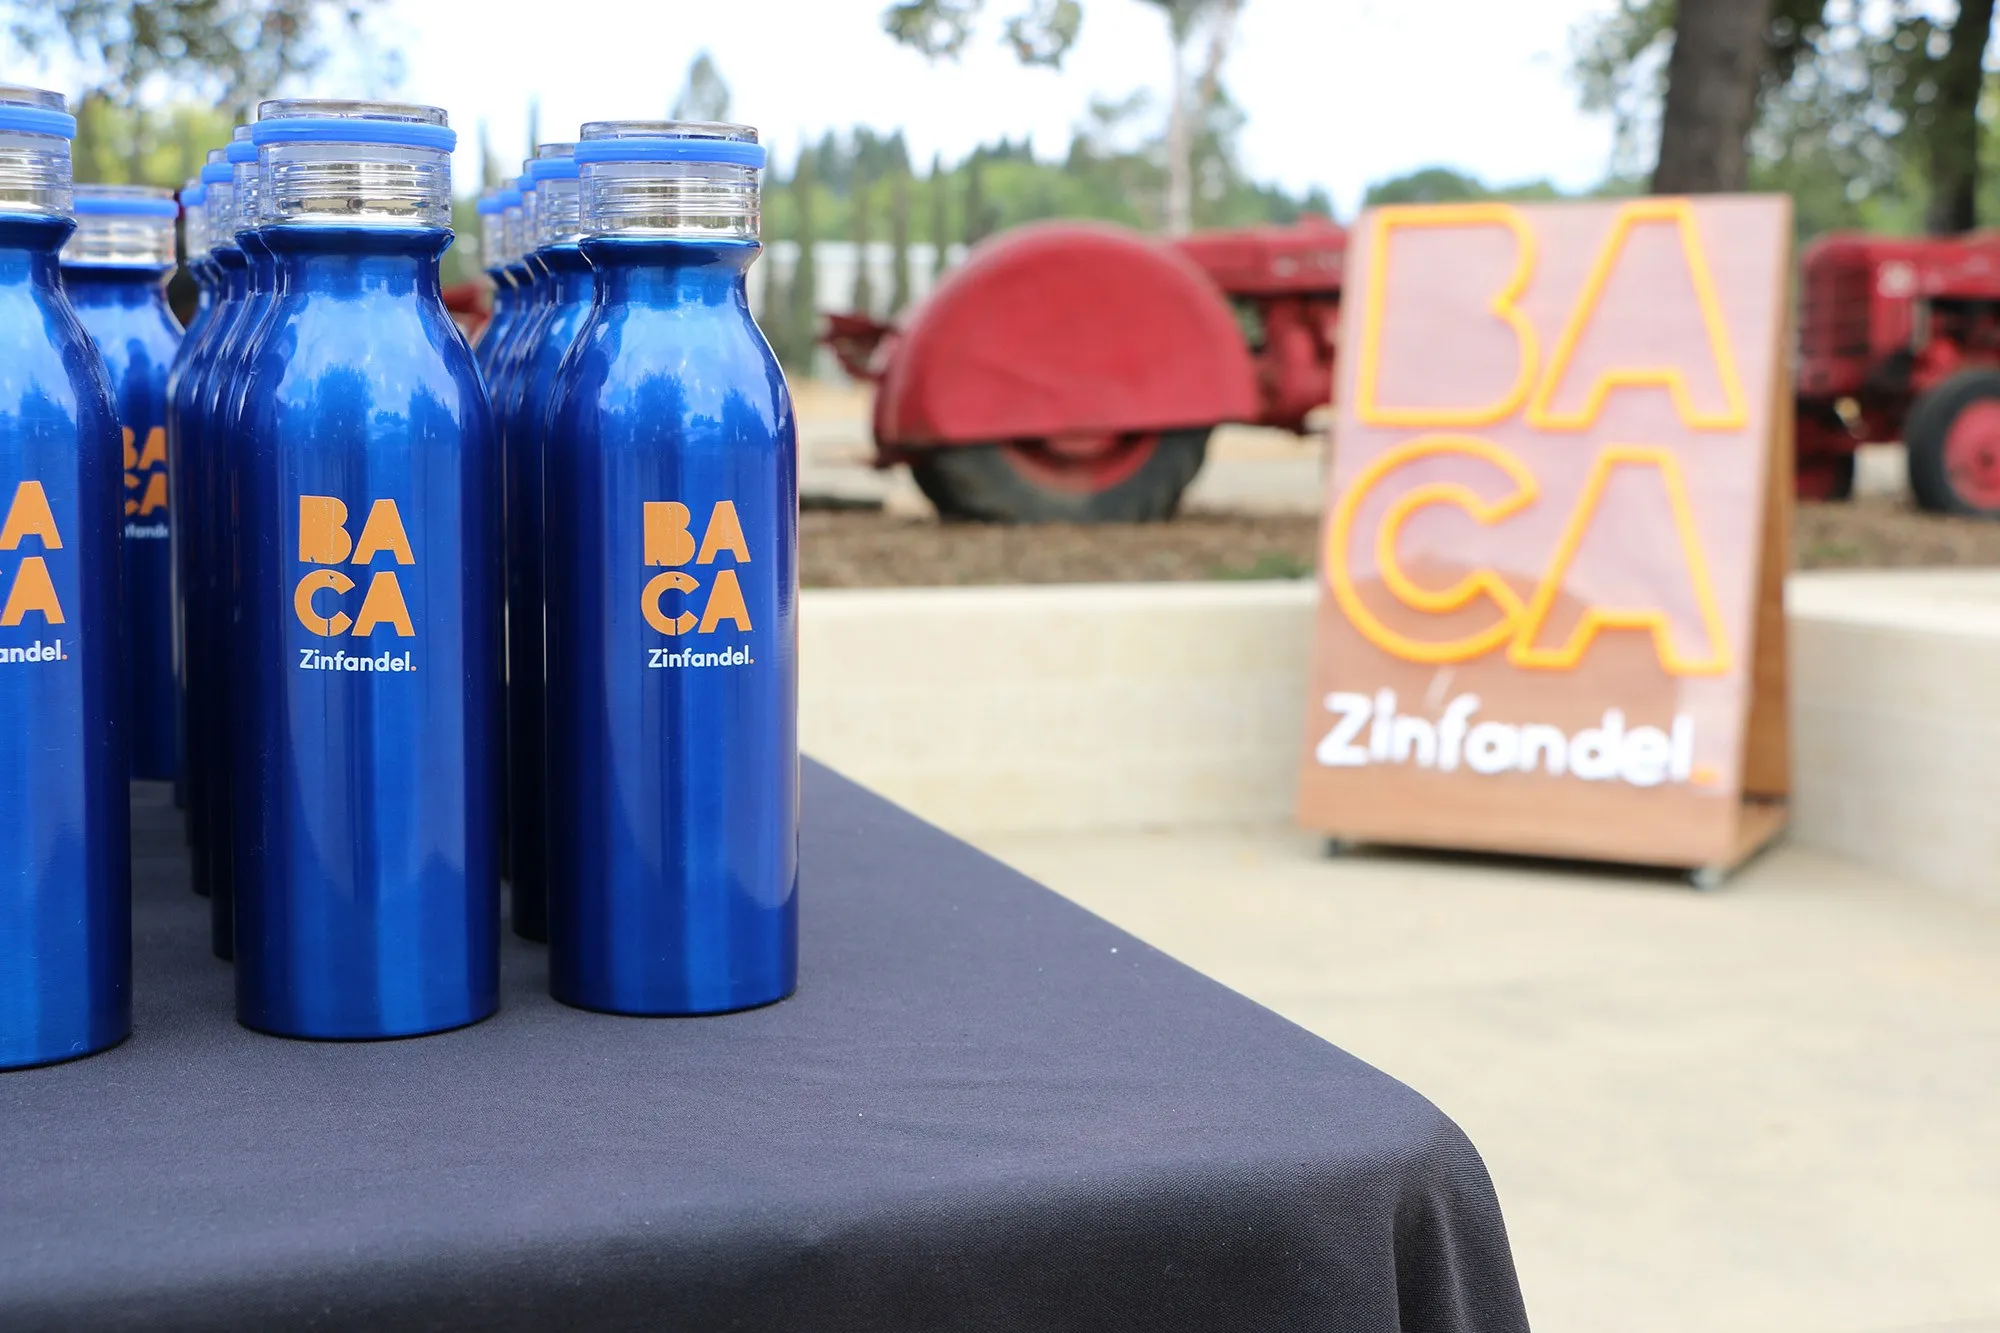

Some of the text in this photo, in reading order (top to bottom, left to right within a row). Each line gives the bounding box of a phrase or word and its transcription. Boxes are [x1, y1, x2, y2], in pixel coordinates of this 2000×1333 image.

[1355, 200, 1748, 430] BA
[299, 495, 416, 565] BA
[643, 500, 751, 567] BA
[1326, 434, 1732, 674] CA
[294, 569, 416, 637] CA
[641, 569, 752, 636] CA
[300, 649, 417, 672] Zinfandel.
[648, 645, 754, 668] Zinfandel.
[1315, 687, 1720, 787] Zinfandel.
